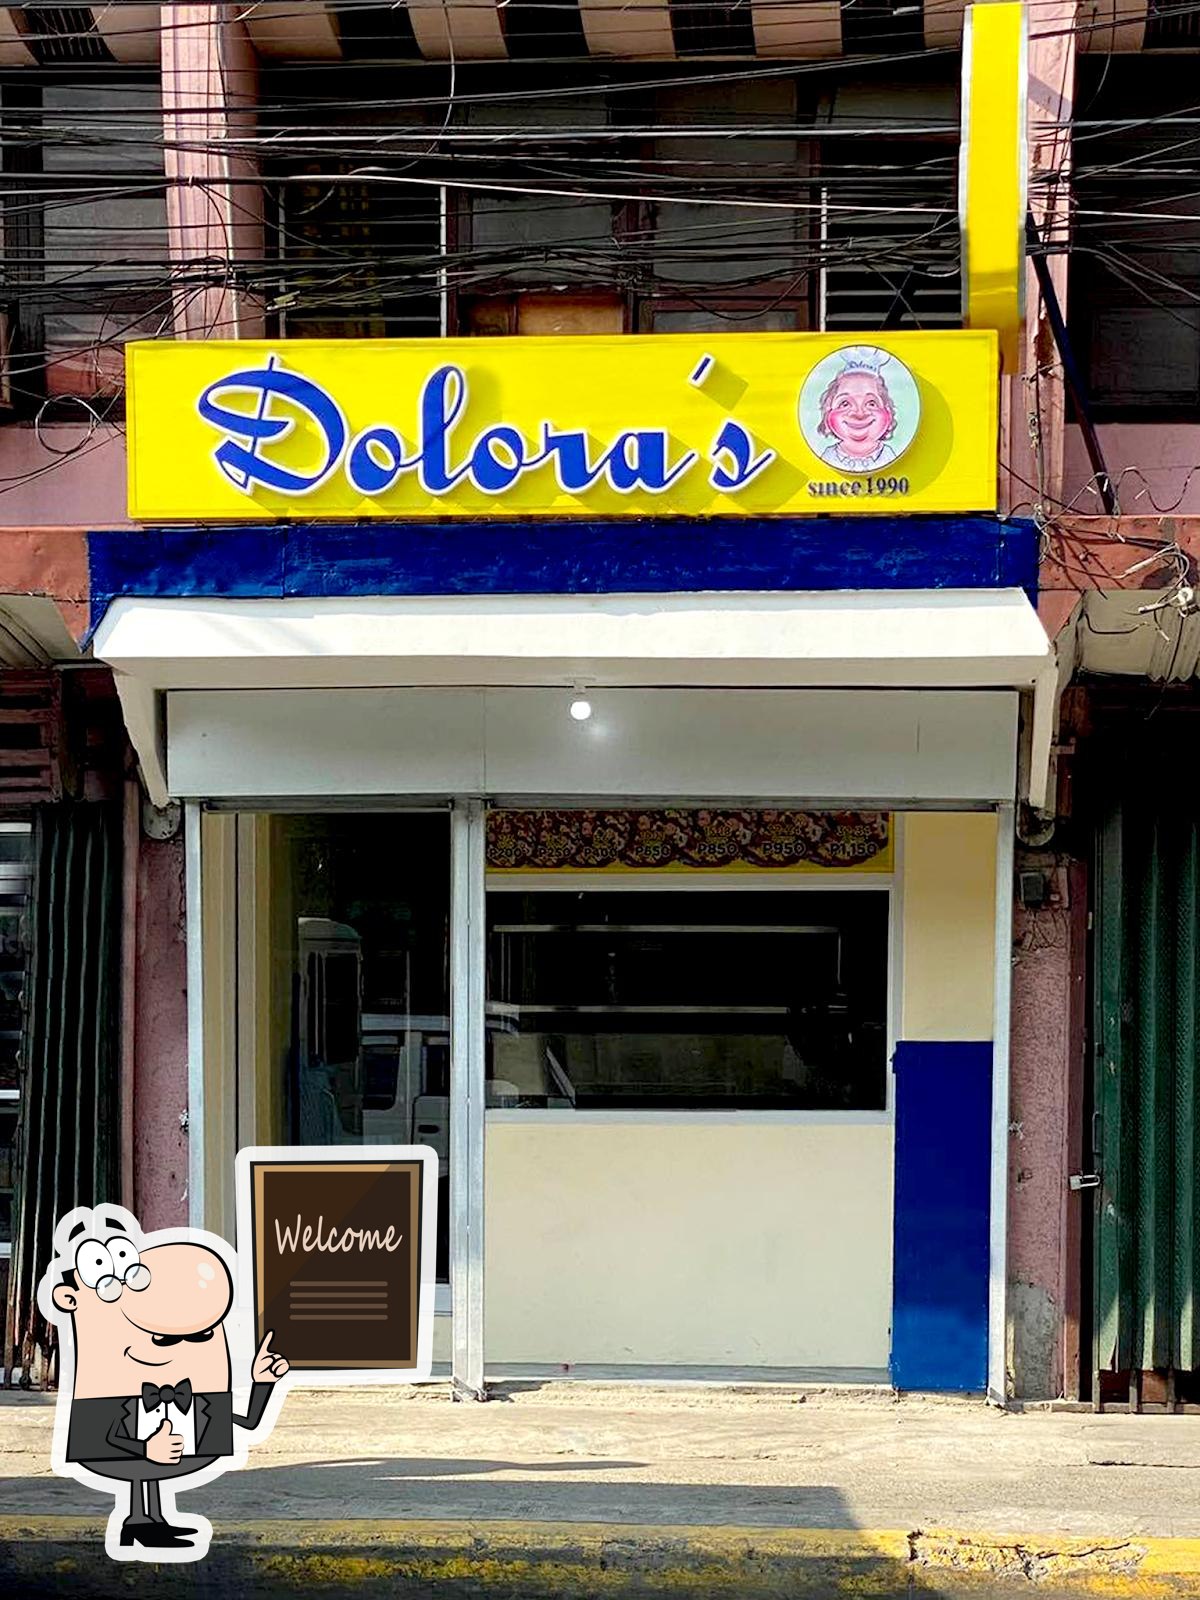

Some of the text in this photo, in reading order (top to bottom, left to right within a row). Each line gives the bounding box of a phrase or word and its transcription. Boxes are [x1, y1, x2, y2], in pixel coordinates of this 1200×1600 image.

[197, 353, 775, 495] Dolora's
[697, 842, 738, 855] P850
[763, 842, 806, 855] P950
